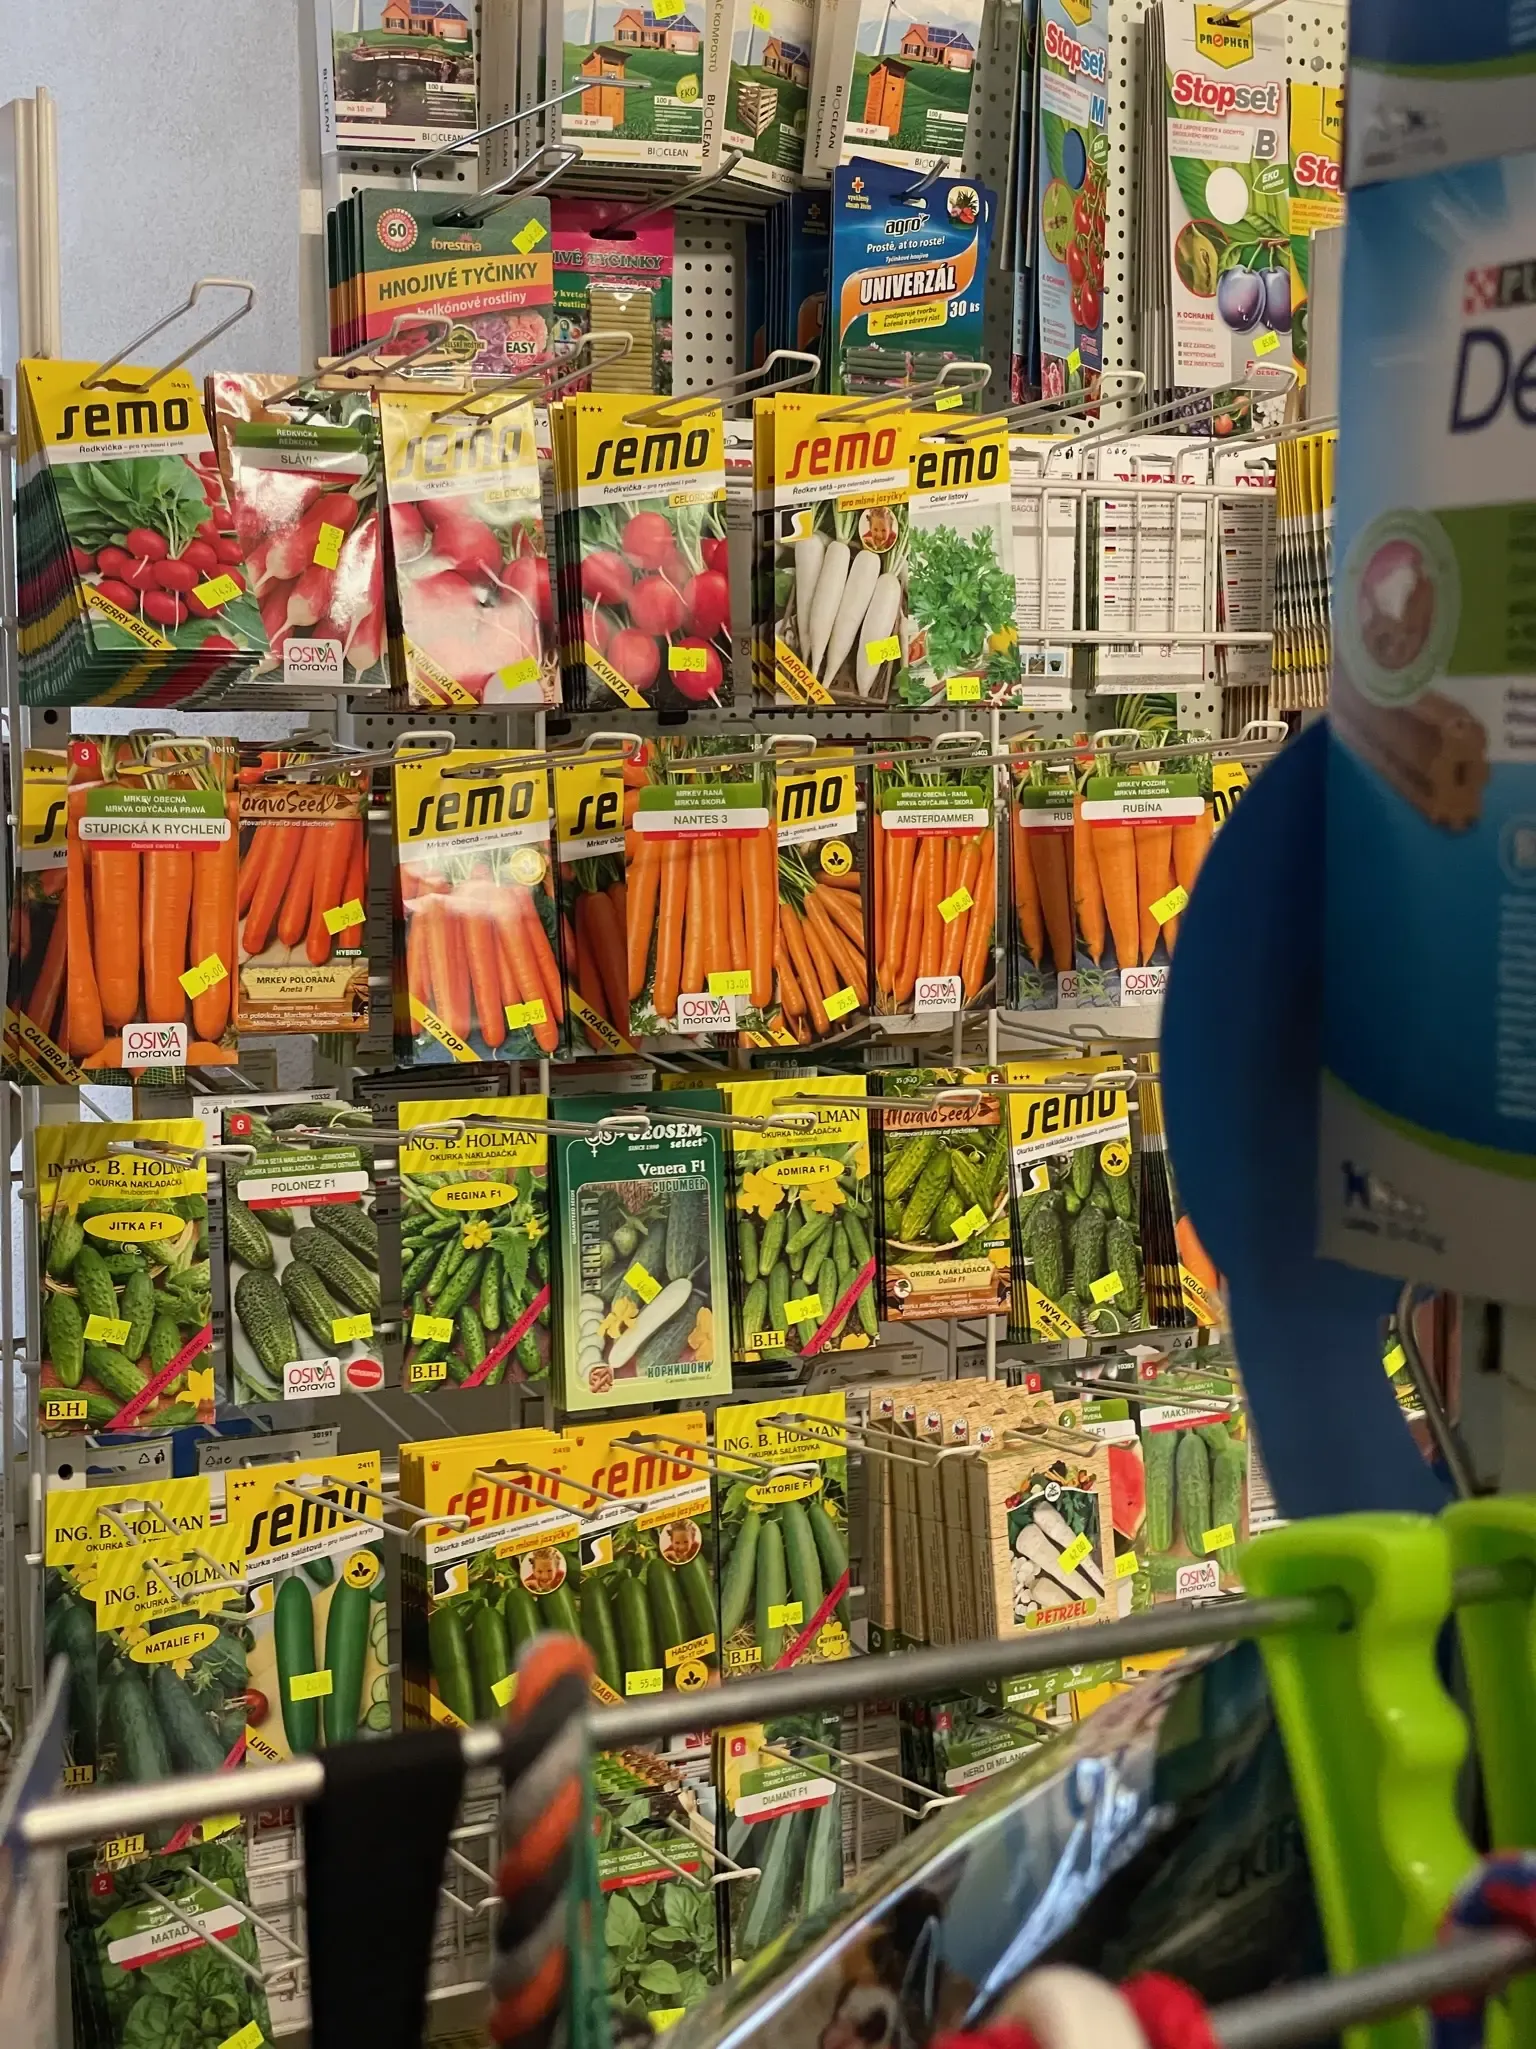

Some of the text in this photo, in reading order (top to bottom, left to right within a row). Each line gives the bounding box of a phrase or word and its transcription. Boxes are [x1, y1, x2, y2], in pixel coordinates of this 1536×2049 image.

[1045, 23, 1105, 80] Stopset
[1174, 74, 1278, 112] Stopset
[1257, 129, 1276, 157] B
[648, 147, 688, 157] BIOCLEAN
[1262, 169, 1279, 182] EKO
[388, 224, 407, 238] 60
[885, 217, 921, 237] agro
[431, 238, 482, 252] forestina
[910, 241, 917, 249] to
[379, 262, 538, 300] HNOJIVÉ TYČINKY
[860, 262, 956, 303] UNIVERZÁL
[484, 290, 527, 306] rostliny
[950, 301, 966, 317] 30
[506, 342, 534, 353] EASY
[57, 398, 189, 440] semo
[587, 428, 710, 480] semo
[785, 429, 896, 479] semo
[90, 596, 163, 649] CHERRY BELLE
[289, 661, 337, 672] moravia
[682, 657, 705, 668] 25.50
[593, 659, 631, 698] KVINTA
[781, 654, 825, 701] JAROLA F1
[451, 685, 466, 701] F1
[80, 748, 90, 760] 3
[634, 752, 641, 761] 2
[153, 795, 186, 803] OBECNÁ
[1114, 788, 1136, 796] MRKVA
[409, 780, 533, 837] semo
[675, 798, 698, 806] MRKVA
[1122, 802, 1162, 813] RUBÍNA
[105, 805, 206, 814] MRKVA OBYČAJNÁ PRAVÁ
[674, 815, 727, 824] NANTES 3
[897, 813, 974, 824] AMSTERDAMMER
[85, 821, 225, 835] STUPICKÁ K RYCHLENÍ
[257, 974, 335, 984] MRKEV POLORANÁ
[726, 979, 749, 989] 13.00
[279, 985, 313, 994] Aneta F1
[919, 997, 956, 1006] moravia
[683, 1015, 730, 1025] moravia
[423, 1013, 463, 1053] TIP-TOP
[580, 1008, 621, 1047] KRÁSKA
[24, 1027, 82, 1083] CALIBRA F1
[128, 1049, 181, 1059] moravia
[237, 1120, 244, 1130] 6
[466, 1132, 537, 1148] HOLMAN
[430, 1150, 517, 1161] OKURKA NAKLADAČKA
[638, 1160, 706, 1176] Venera F1
[777, 1166, 816, 1176] ADMIRA
[88, 1178, 127, 1188] OKURKA
[271, 1179, 336, 1192] POLONEZ F1
[652, 1179, 706, 1193] CUCUMBER
[447, 1189, 501, 1200] REGINA F1
[109, 1221, 163, 1231] JITKA F1
[943, 1265, 991, 1276] NAKLADAČKA
[1036, 1298, 1072, 1332] ANYA F1
[754, 1334, 783, 1347] B.H.
[412, 1365, 444, 1379] B.H.
[1146, 1366, 1153, 1376] 6
[289, 1381, 336, 1392] moravia
[1030, 1378, 1036, 1387] 6
[49, 1403, 84, 1417] B.H.
[724, 1438, 753, 1452] ING.
[758, 1434, 773, 1446] B.
[358, 1461, 374, 1469] 2411
[756, 1480, 813, 1496] VIKTORIE F1
[55, 1526, 87, 1543] ING.
[100, 1524, 116, 1539] B.
[86, 1542, 123, 1552] OKURKA
[434, 1544, 458, 1554] Okurka
[105, 1589, 140, 1606] ING.
[146, 1579, 162, 1596] B.
[1179, 1581, 1217, 1595] moravia
[134, 1598, 169, 1612] OKURKA
[145, 1632, 206, 1654] NATALIE F1
[671, 1638, 709, 1656] HADOVKA
[731, 1650, 759, 1664] B.H.
[942, 1717, 947, 1725] 2
[249, 1736, 278, 1760] LIVIE
[734, 1741, 742, 1752] 6
[763, 1786, 808, 1805] DIAMANT F1
[108, 1838, 141, 1857] B.H.
[100, 1880, 107, 1890] 2
